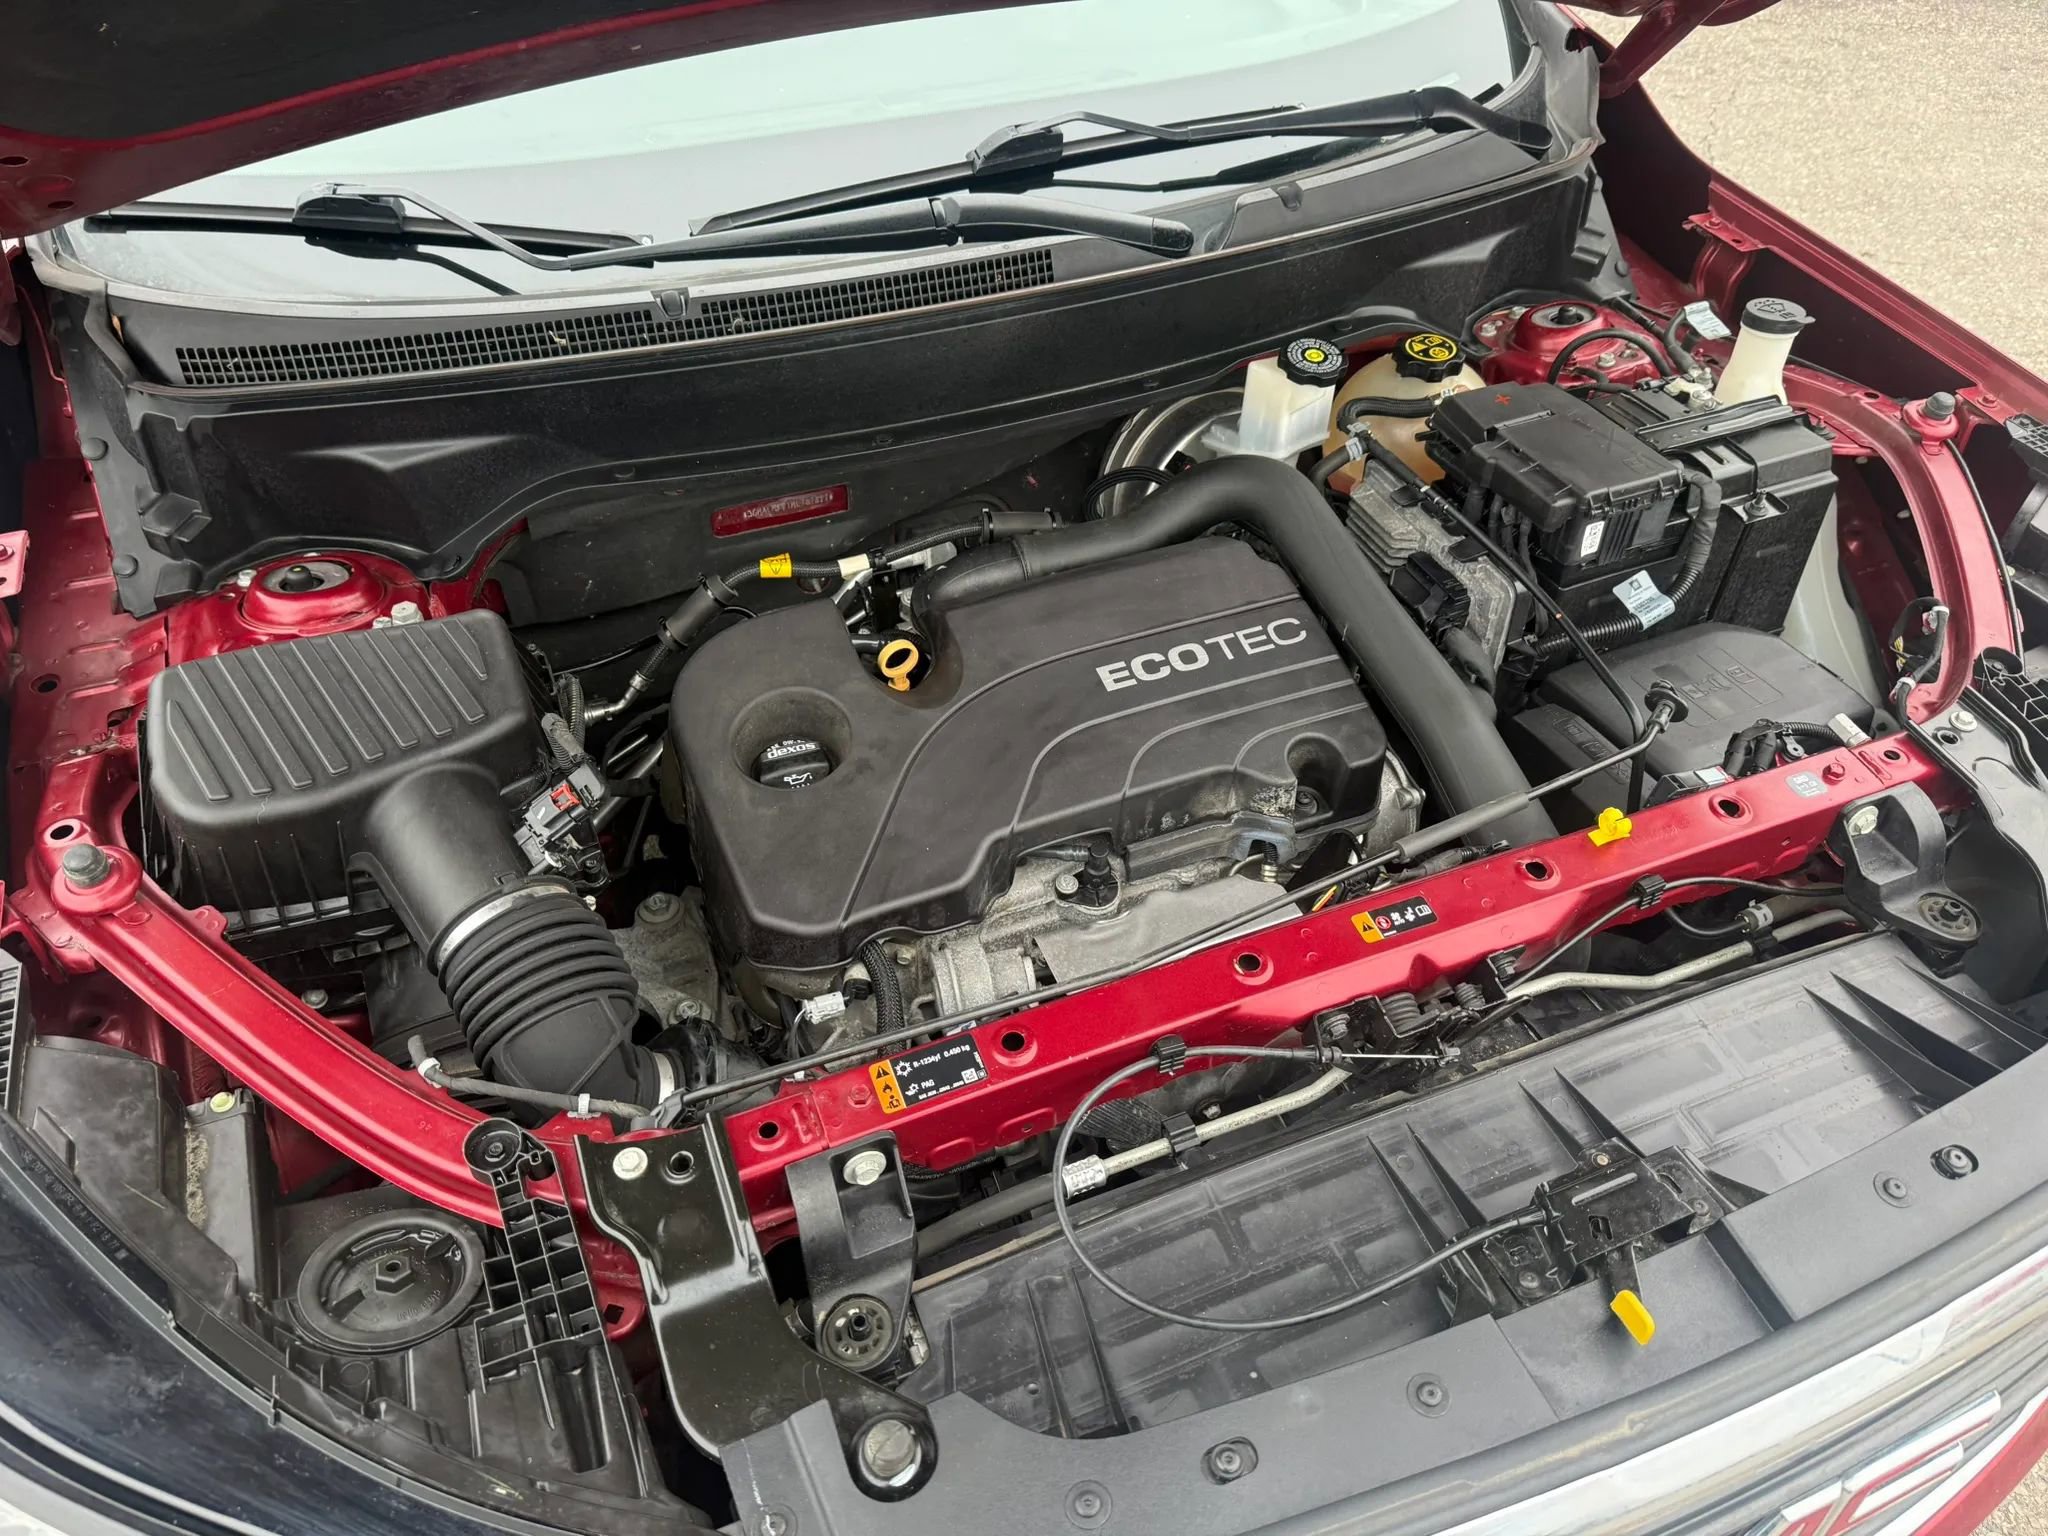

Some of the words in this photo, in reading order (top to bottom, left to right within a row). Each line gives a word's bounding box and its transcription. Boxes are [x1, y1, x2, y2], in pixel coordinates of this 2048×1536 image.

[1095, 617, 1308, 692] ECOTEC
[767, 742, 817, 759] dexos
[913, 1052, 942, 1069] R-1234yf
[920, 1079, 935, 1090] PAG
